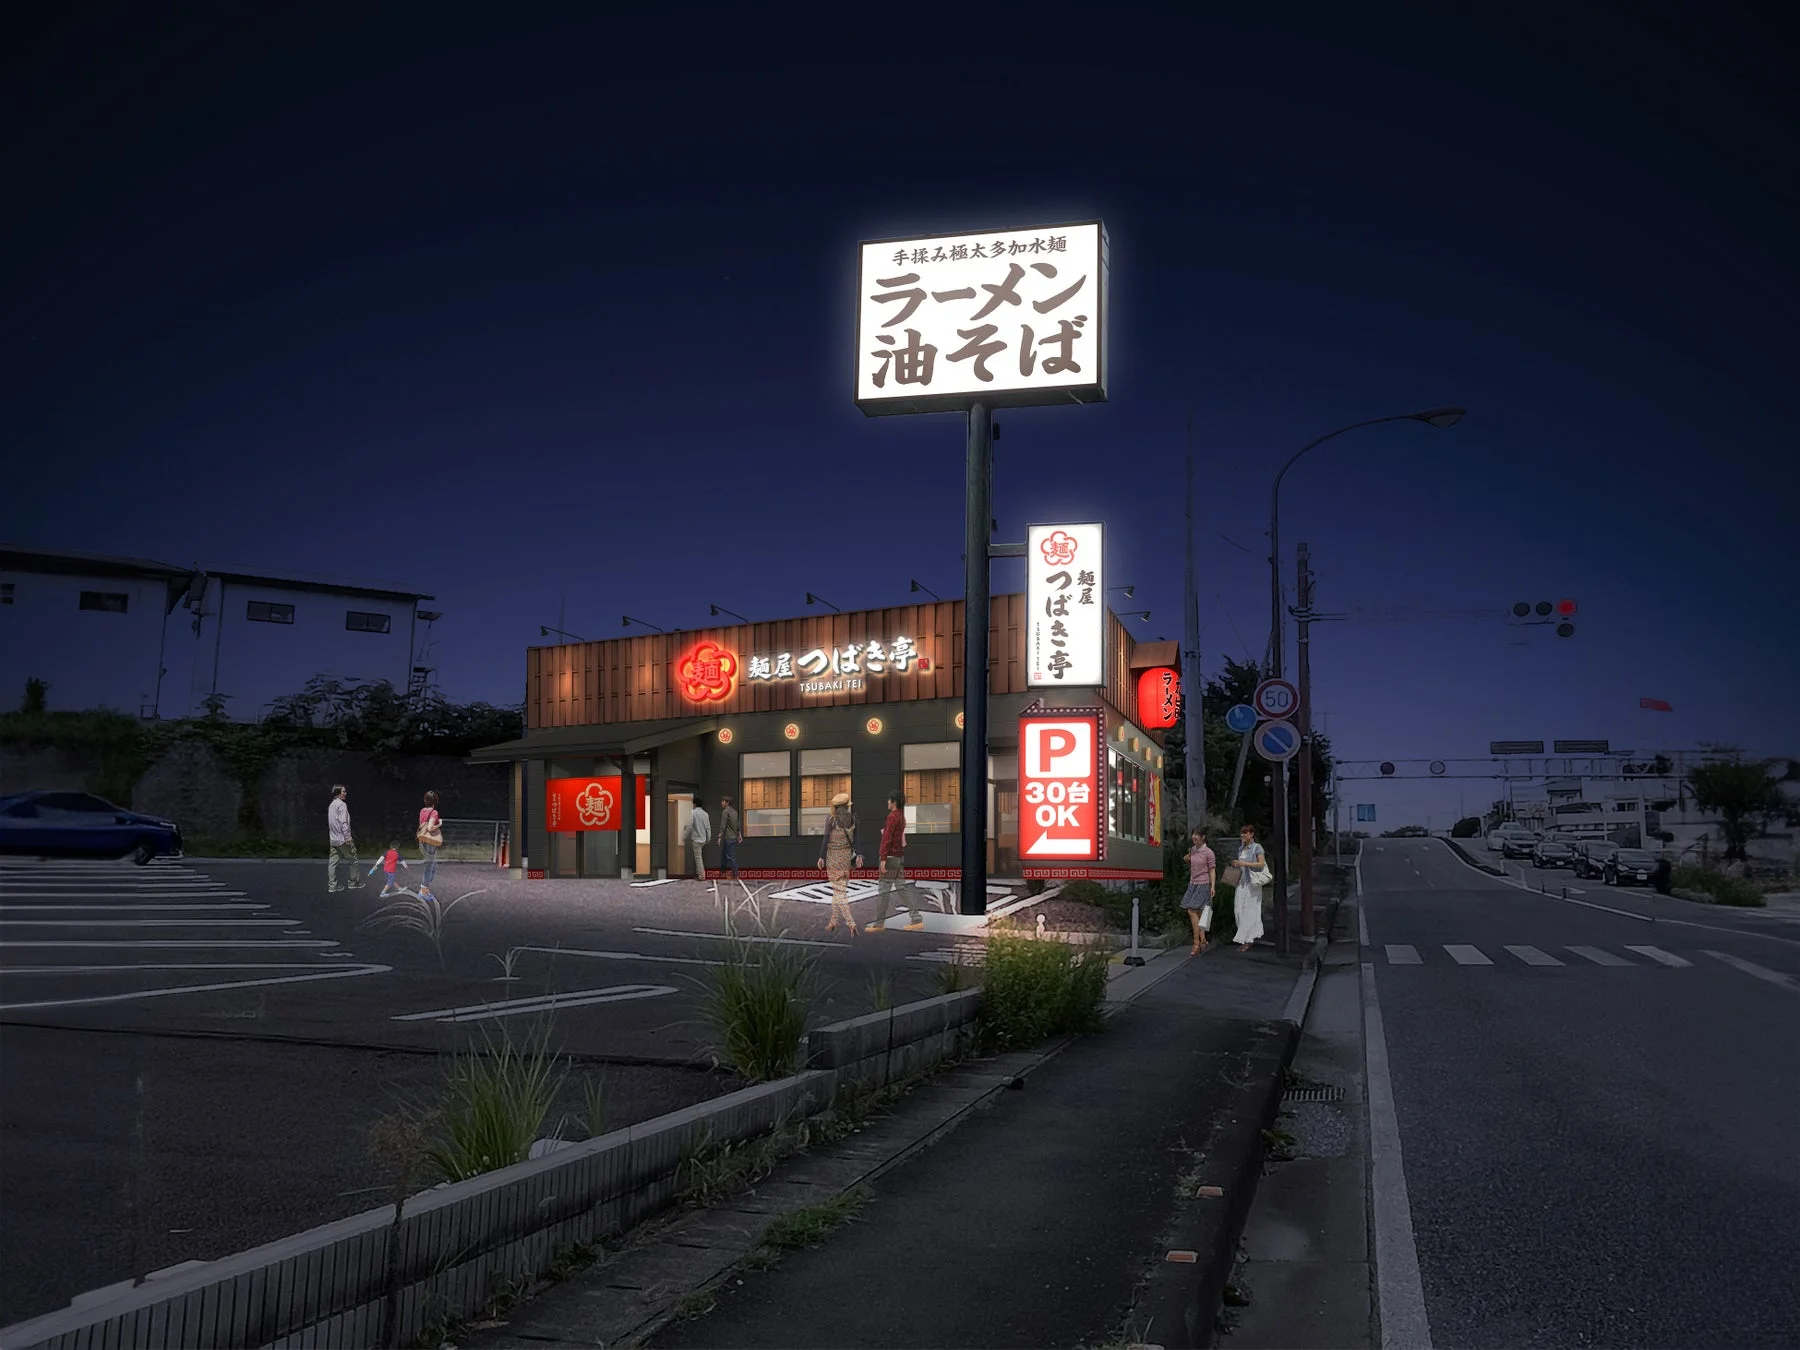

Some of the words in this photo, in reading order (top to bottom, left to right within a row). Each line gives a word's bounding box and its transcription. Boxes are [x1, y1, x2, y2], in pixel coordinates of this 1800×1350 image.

[892, 235, 1067, 266] 手揉み極太多加水麺
[870, 262, 1087, 328] ラーメン
[870, 315, 1088, 388] 油そば
[1050, 541, 1069, 558] 麺
[1077, 569, 1096, 605] 麺屋
[1045, 570, 1072, 679] つばき亭
[691, 658, 721, 688] 麺
[748, 636, 918, 679] 麺屋つばき亭
[800, 680, 843, 693] TSUBAKI
[846, 679, 862, 690] TEI
[1163, 672, 1172, 720] ラーメン
[1265, 690, 1289, 707] 50
[1039, 728, 1076, 772] P
[585, 796, 604, 815] 麺
[1025, 781, 1090, 804] 30台
[1035, 804, 1080, 828] OK
